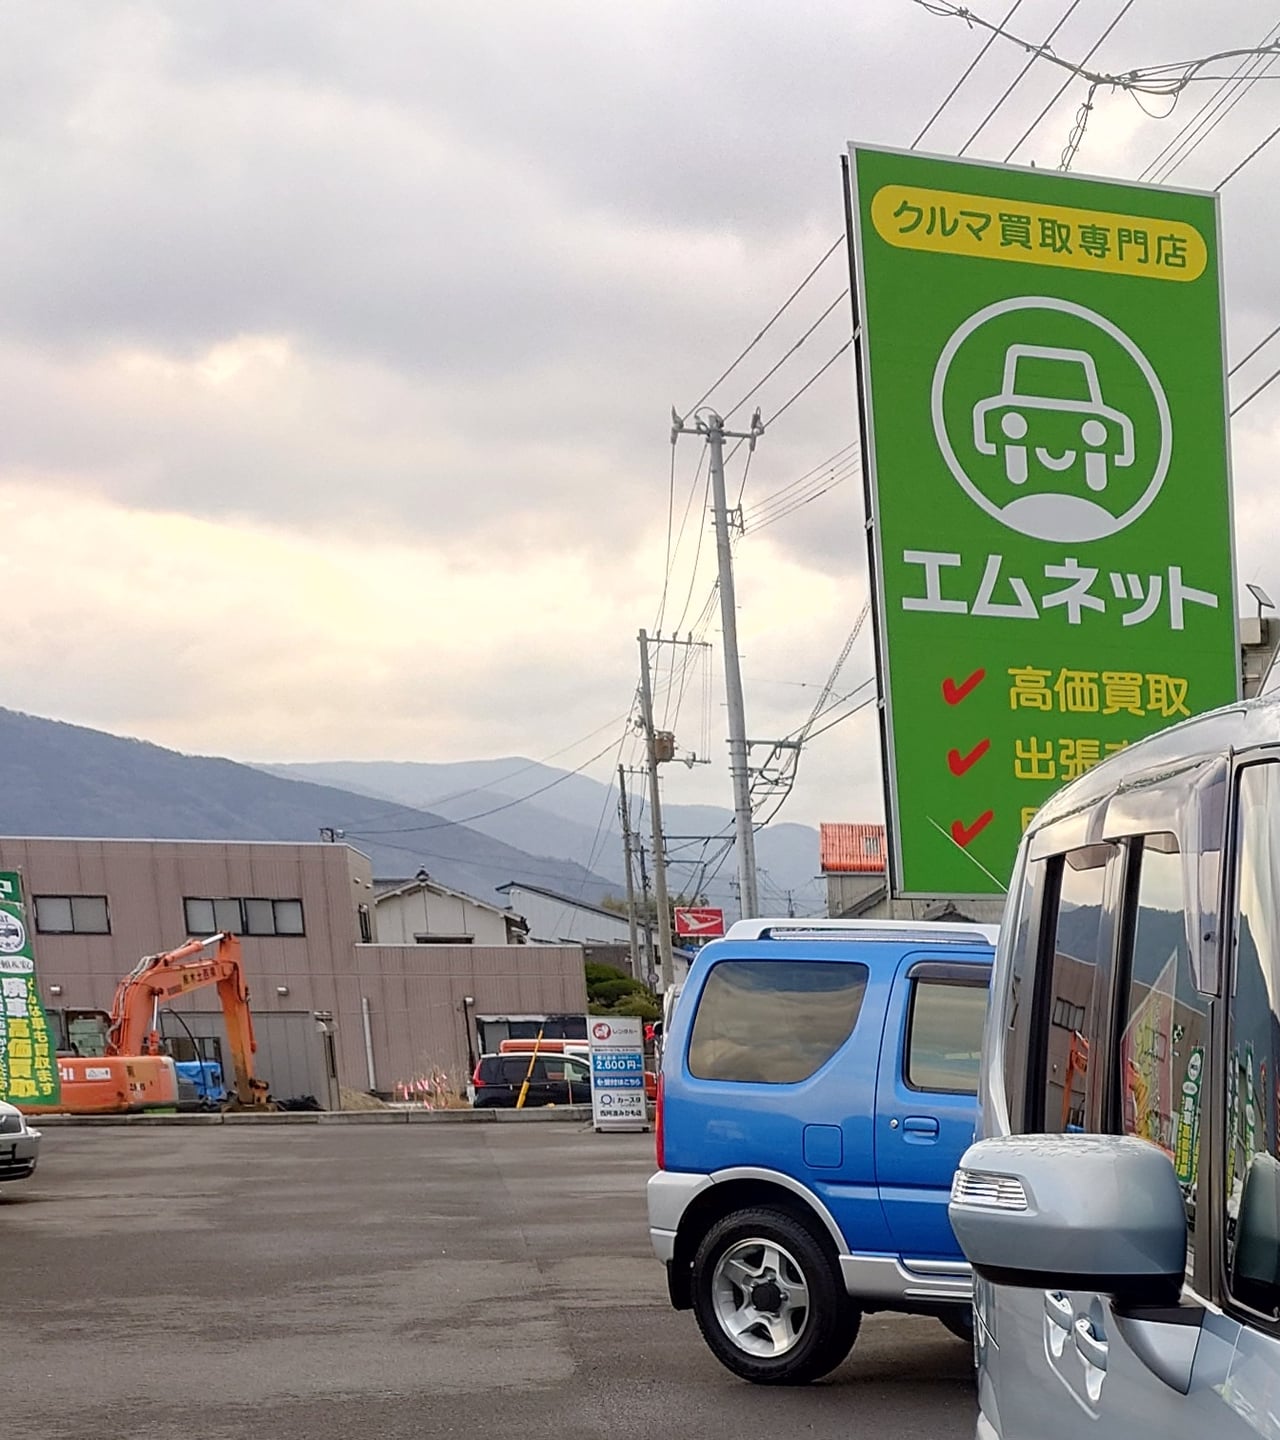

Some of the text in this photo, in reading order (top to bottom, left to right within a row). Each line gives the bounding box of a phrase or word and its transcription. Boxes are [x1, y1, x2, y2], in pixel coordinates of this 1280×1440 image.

[892, 200, 1189, 269] クルマ買取専門店
[902, 549, 1219, 630] エムネット
[1007, 665, 1191, 717] 高価買取
[1014, 736, 1132, 781] 出張
